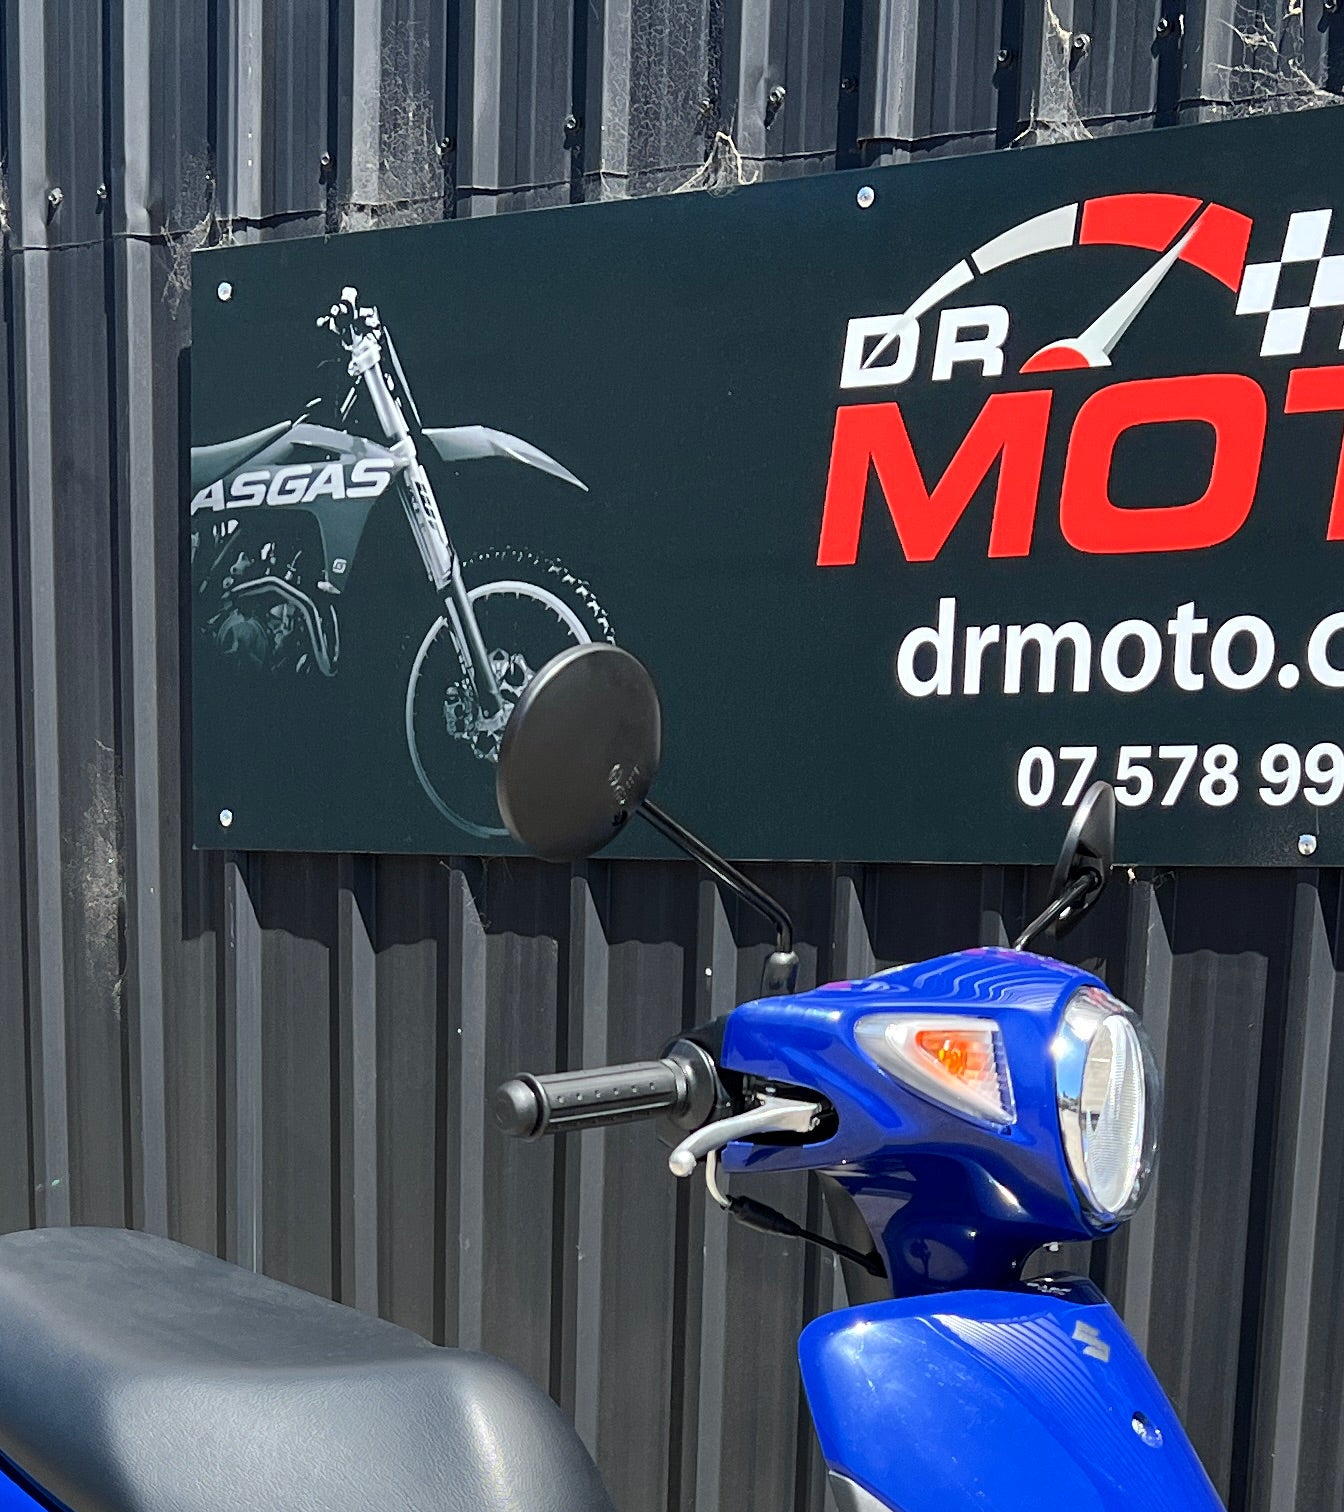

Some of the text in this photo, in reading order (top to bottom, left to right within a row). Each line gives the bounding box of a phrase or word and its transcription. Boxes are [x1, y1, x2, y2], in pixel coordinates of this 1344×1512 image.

[840, 303, 1010, 389] DR
[1016, 744, 1099, 808] 07
[1113, 743, 1240, 808] 578
